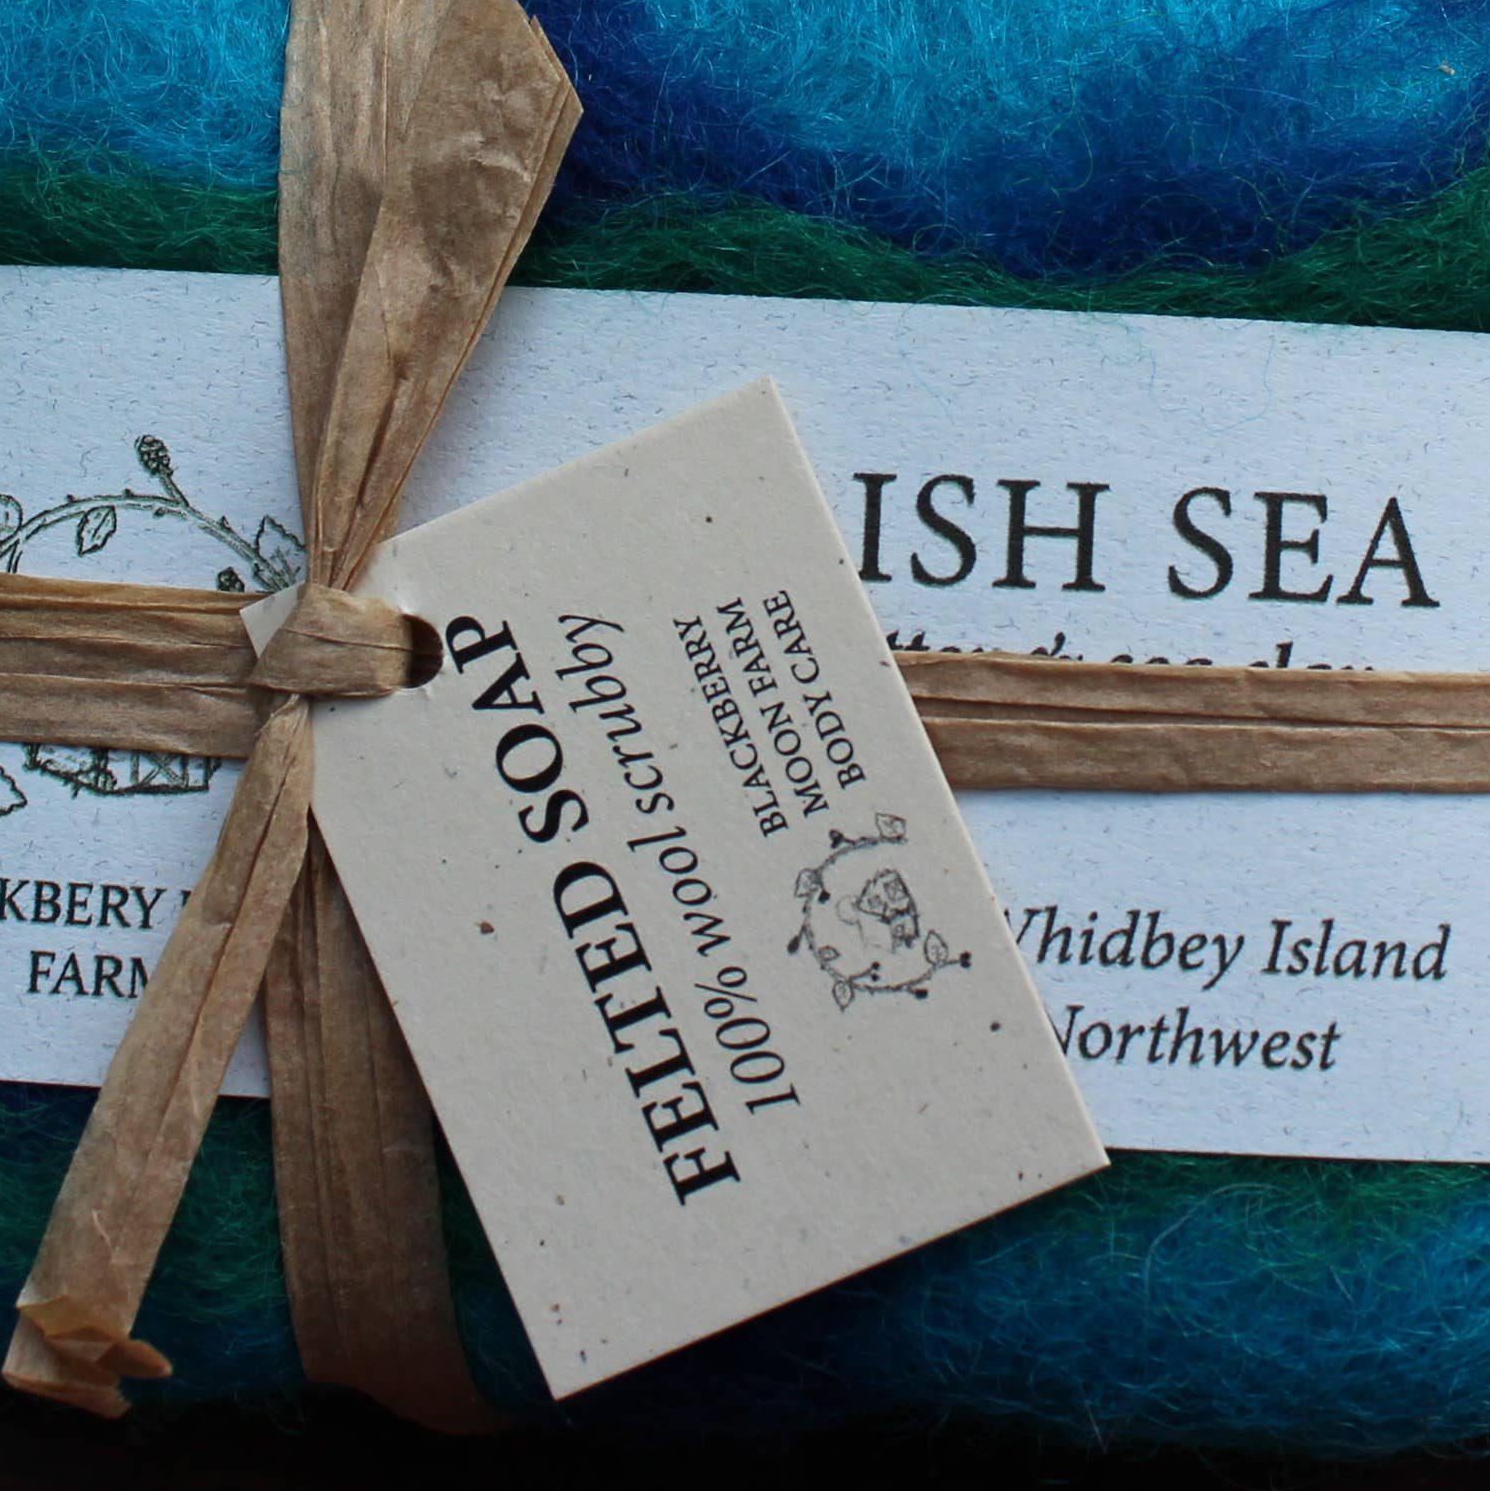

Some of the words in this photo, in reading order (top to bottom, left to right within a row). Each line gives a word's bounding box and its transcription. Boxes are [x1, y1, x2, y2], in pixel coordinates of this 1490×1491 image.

[1167, 485, 1441, 609] SEA
[715, 596, 779, 698] FARM
[763, 589, 821, 685] CARE
[444, 613, 591, 845] SOAP
[554, 612, 677, 816] scrubby
[672, 615, 789, 838] BLACKBERRY
[759, 701, 830, 818] MOON
[802, 690, 867, 790] BODY
[625, 825, 733, 958] wool
[1263, 917, 1451, 982] Island
[551, 860, 742, 1207] FELTED
[693, 964, 802, 1115] 100%
